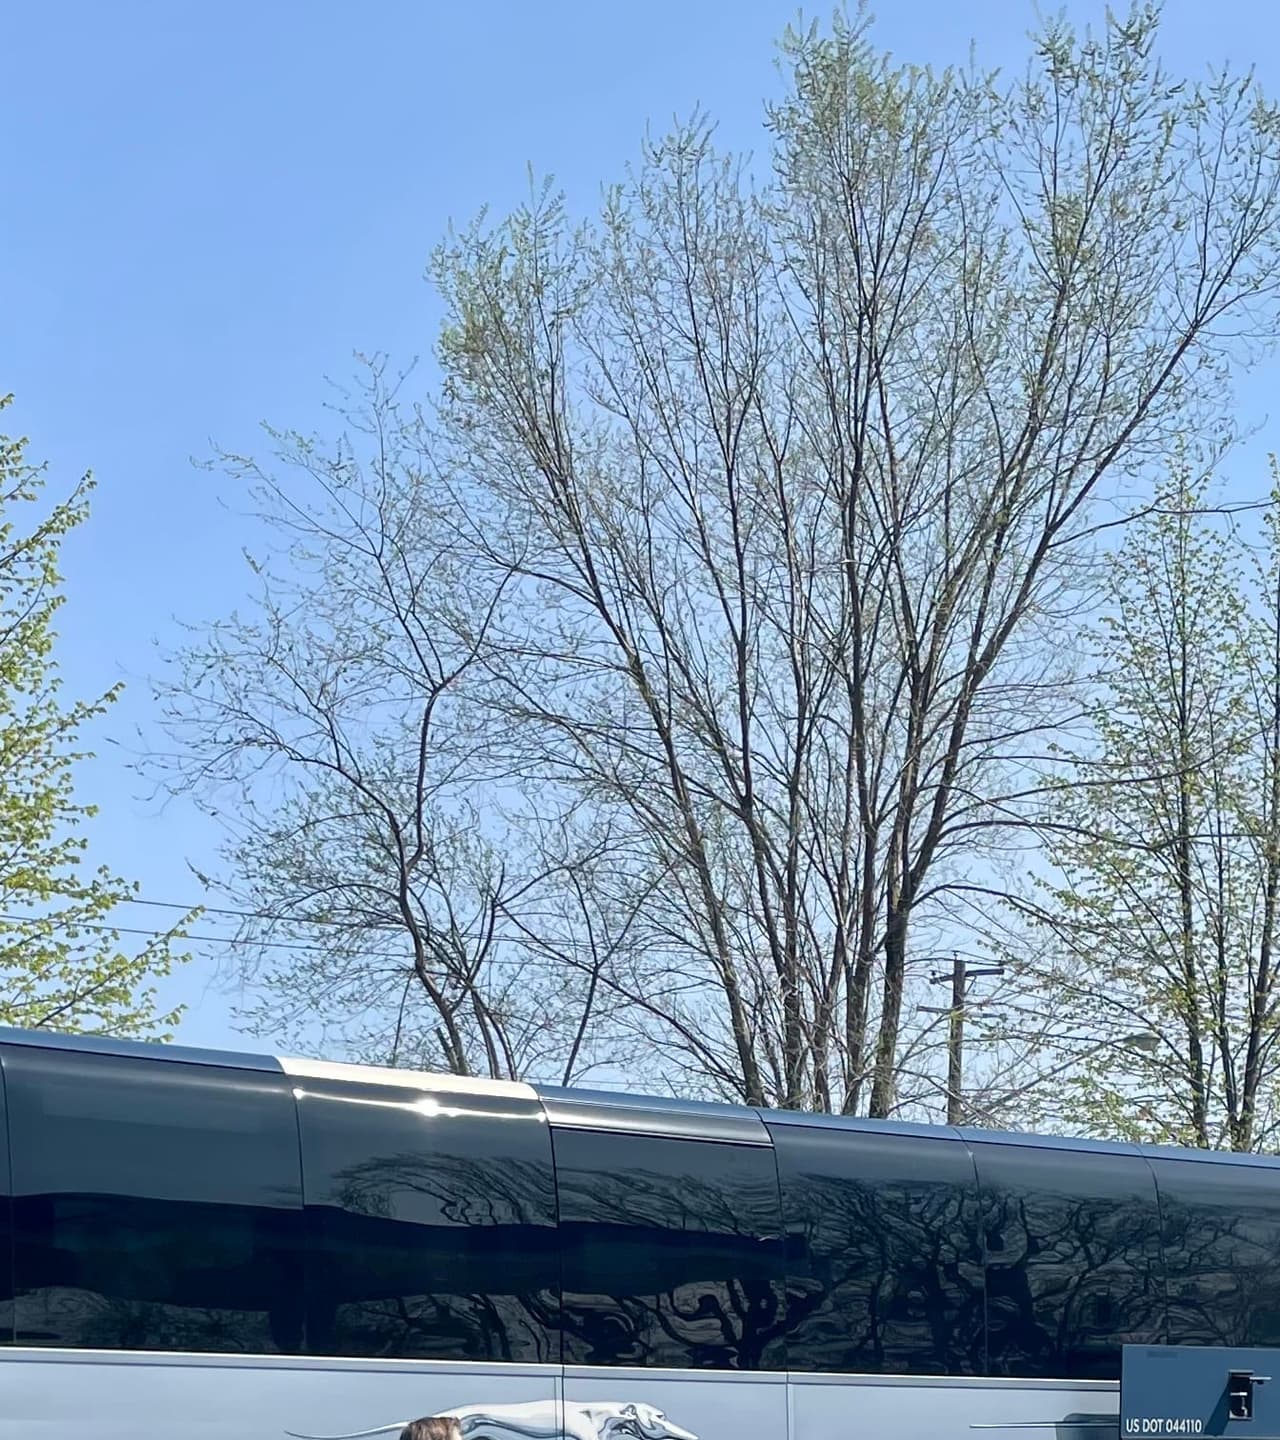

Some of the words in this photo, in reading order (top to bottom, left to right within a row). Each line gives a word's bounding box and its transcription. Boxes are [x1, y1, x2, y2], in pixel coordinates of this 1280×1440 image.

[1126, 1418, 1140, 1433] US
[1142, 1418, 1164, 1433] DOT
[1166, 1418, 1202, 1433] 044110
